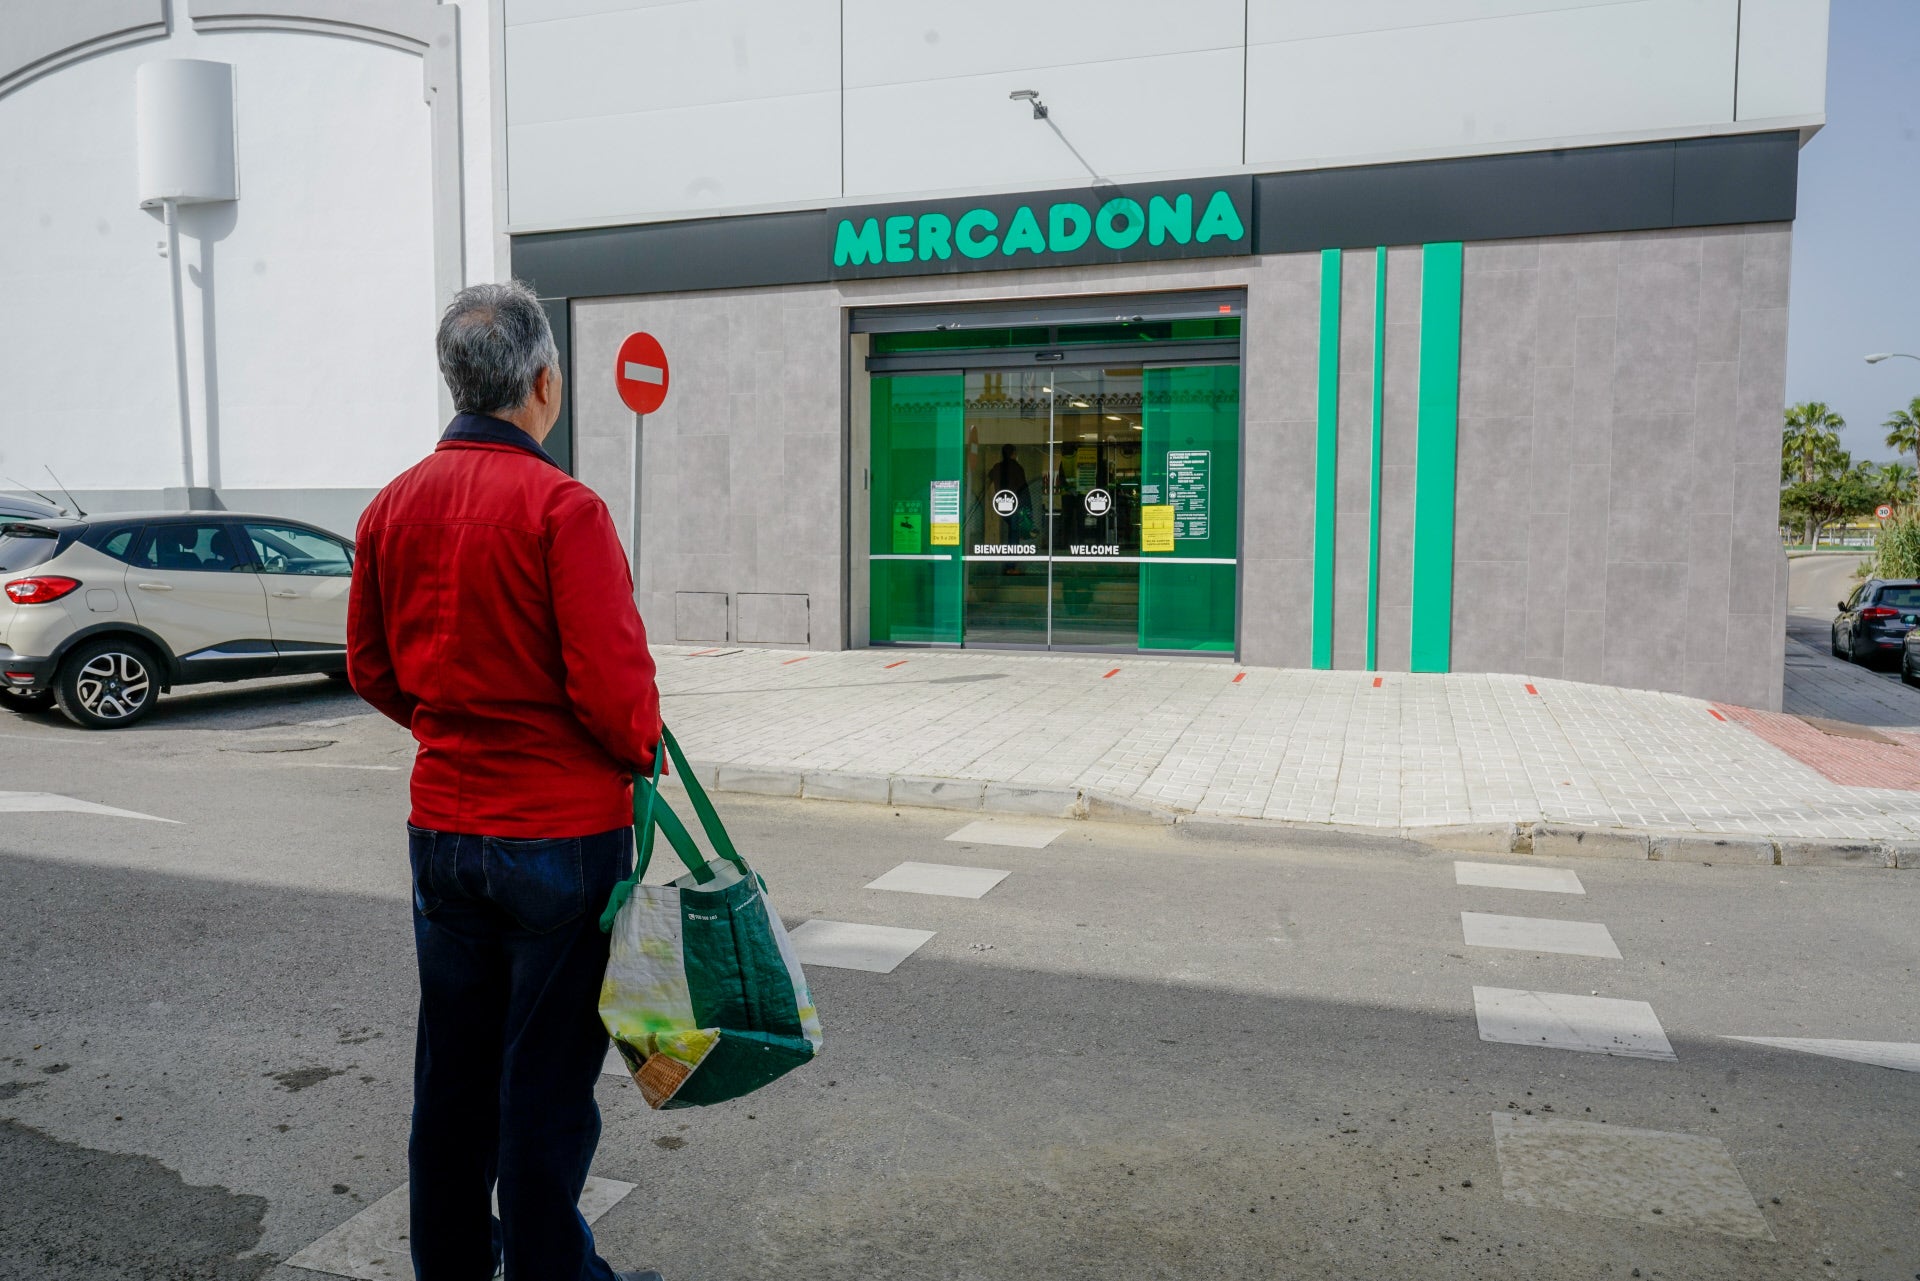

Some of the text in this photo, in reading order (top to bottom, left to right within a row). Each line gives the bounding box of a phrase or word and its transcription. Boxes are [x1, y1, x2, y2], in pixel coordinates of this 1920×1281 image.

[833, 190, 1245, 267] MERCADONA
[974, 544, 1036, 555] BIENVENIDOS
[1070, 544, 1120, 555] WELCOME
